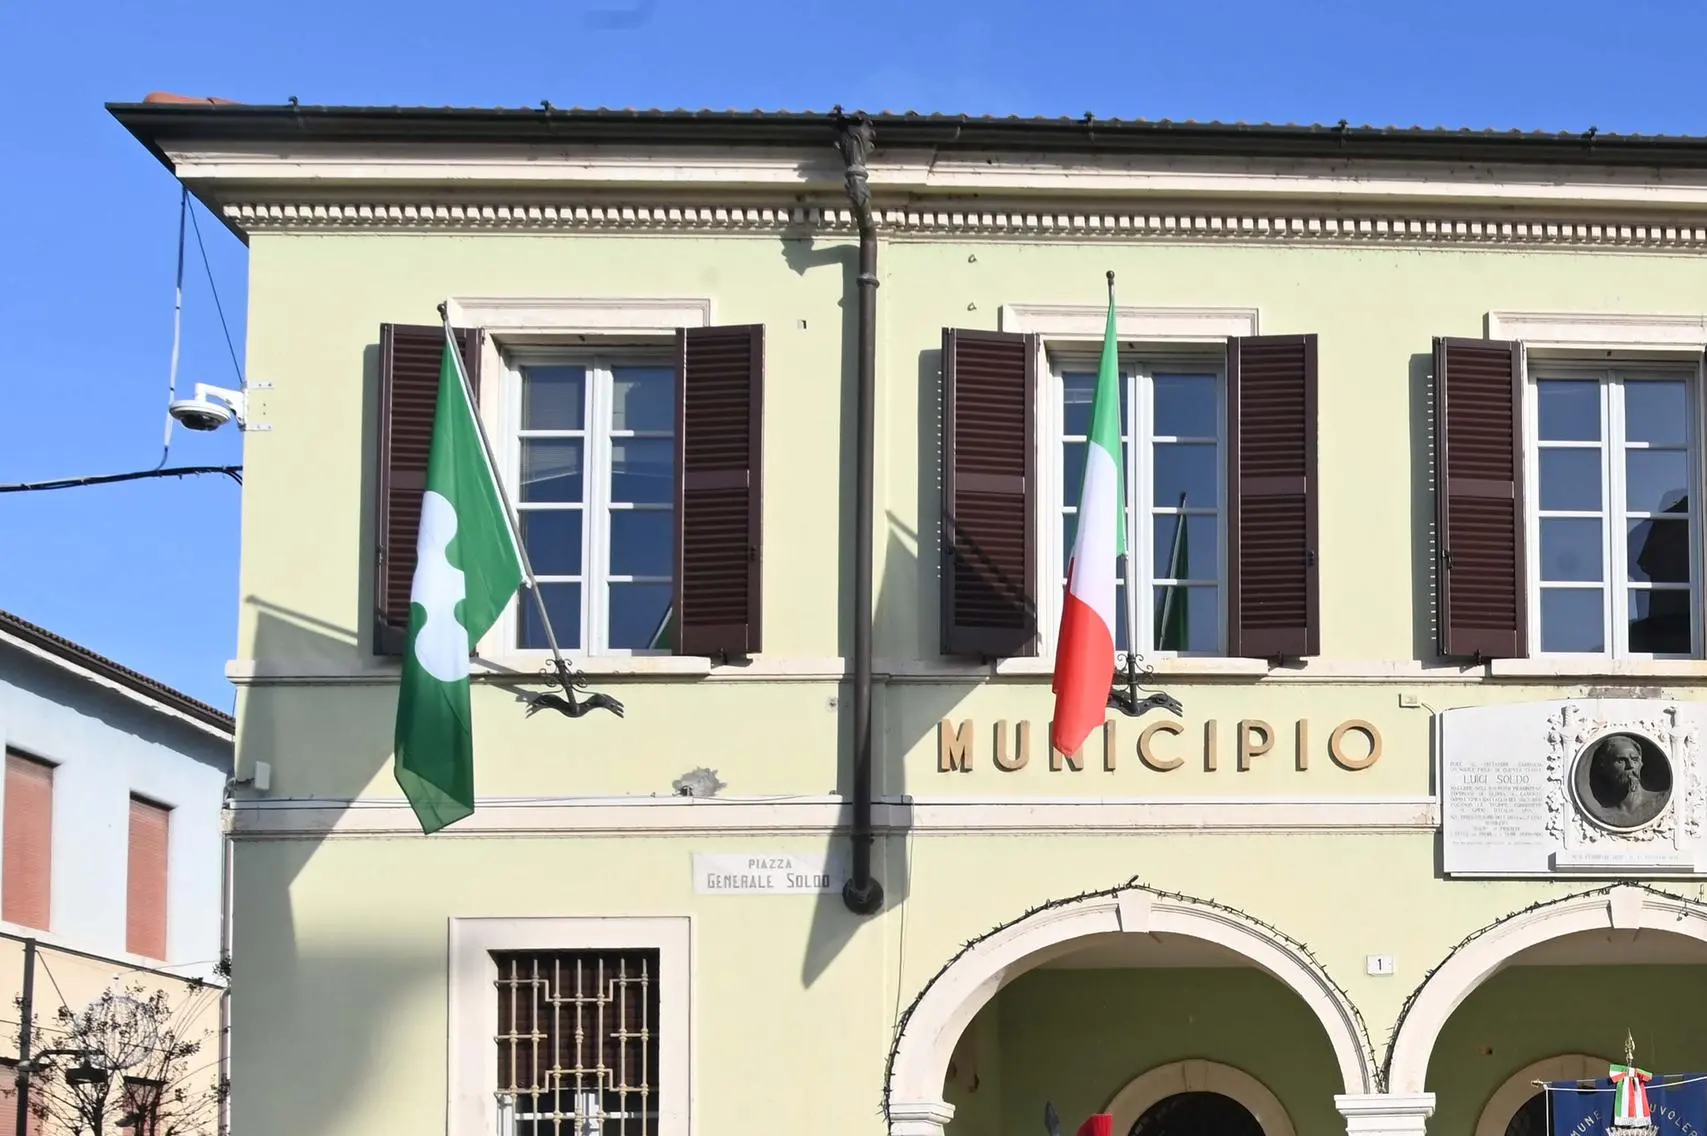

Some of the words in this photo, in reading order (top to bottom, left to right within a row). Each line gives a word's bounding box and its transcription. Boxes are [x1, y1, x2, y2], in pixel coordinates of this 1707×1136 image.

[748, 858, 793, 869] PIAZZA
[707, 873, 775, 889] GENERALE
[786, 873, 830, 888] SOLDO
